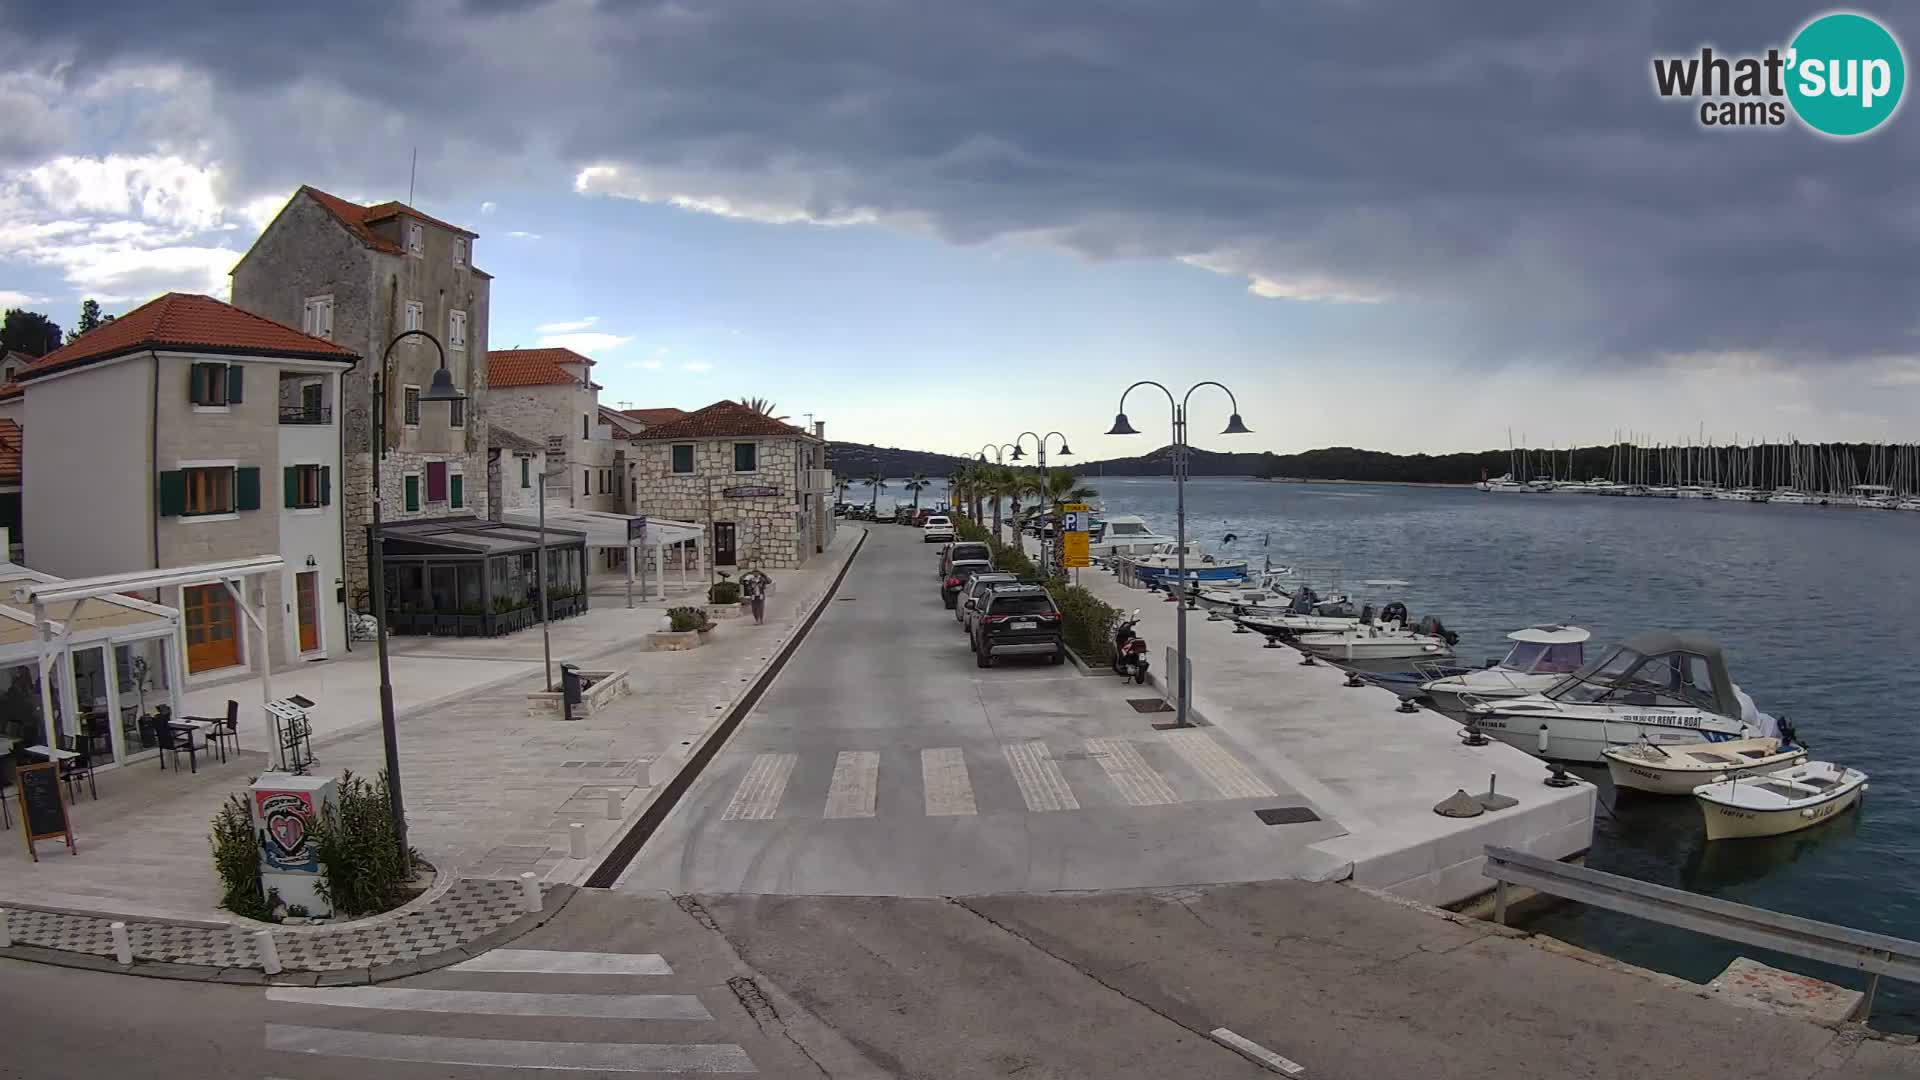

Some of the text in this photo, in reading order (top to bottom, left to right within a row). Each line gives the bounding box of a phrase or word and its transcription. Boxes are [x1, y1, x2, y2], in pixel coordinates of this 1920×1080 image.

[1065, 513, 1076, 529] P
[1656, 715, 1677, 725] RENT
[1684, 716, 1703, 728] BOAT
